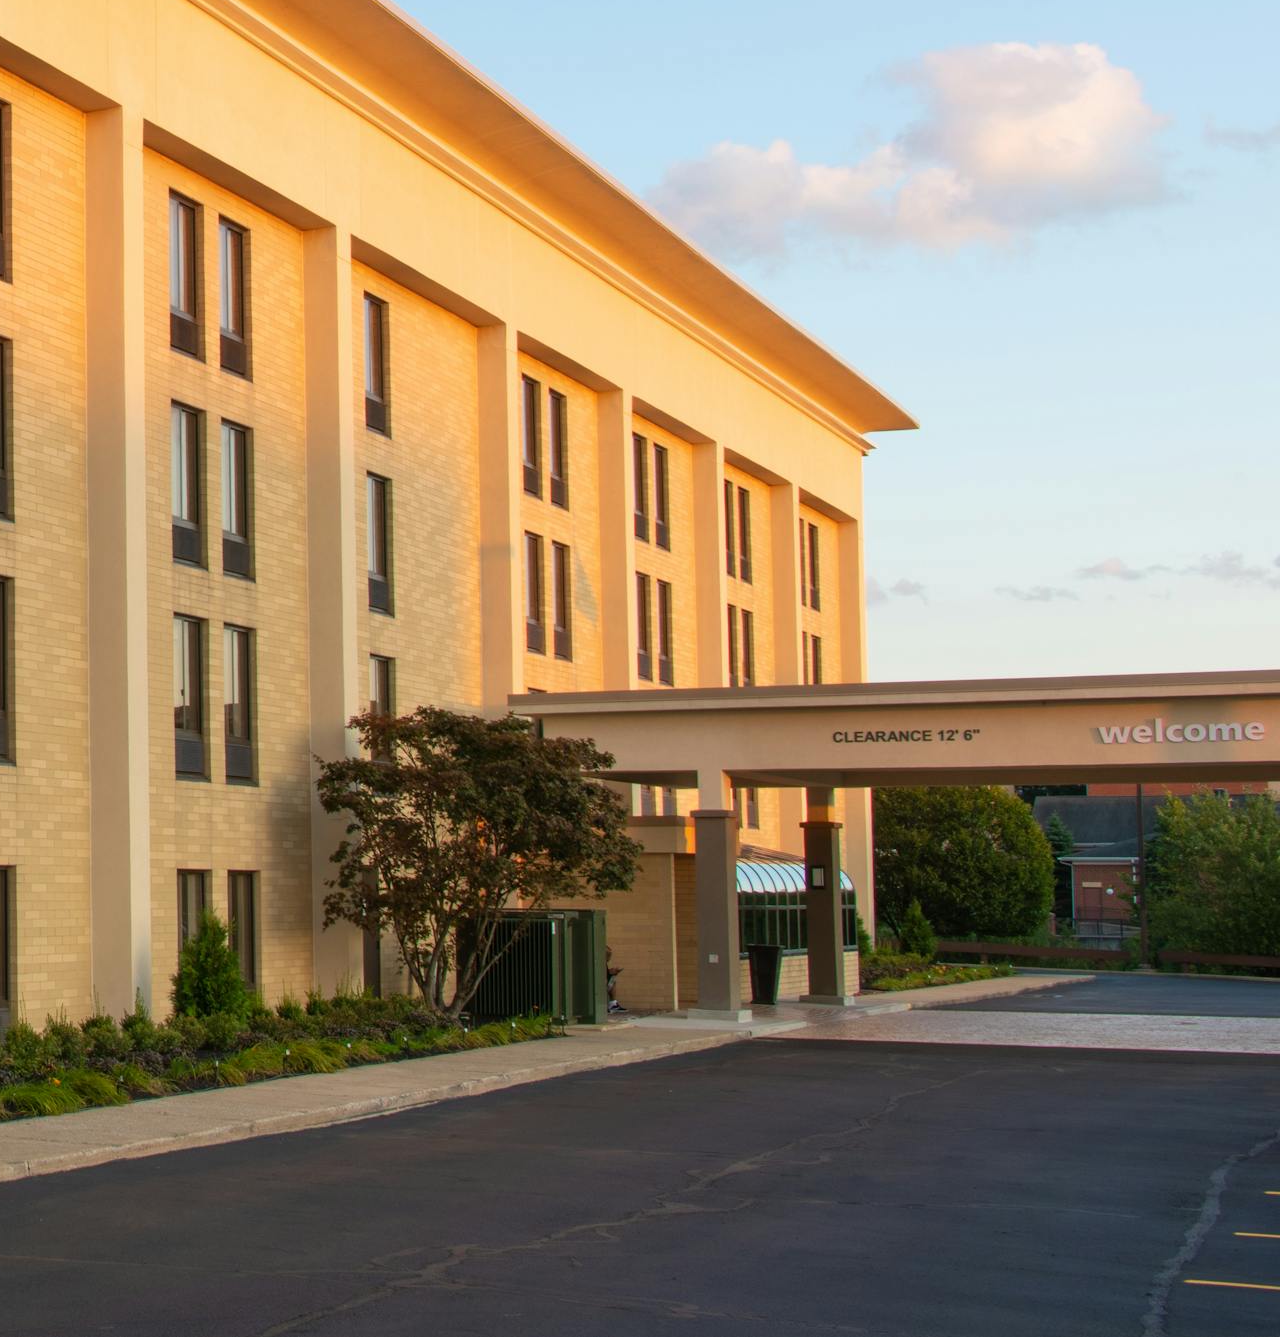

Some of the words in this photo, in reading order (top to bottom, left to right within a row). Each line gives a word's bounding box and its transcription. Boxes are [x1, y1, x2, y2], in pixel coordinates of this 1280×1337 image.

[832, 730, 933, 743] CLEARANCE
[937, 729, 959, 742] 12'
[963, 729, 981, 741] 6"
[1097, 717, 1265, 744] welcome
